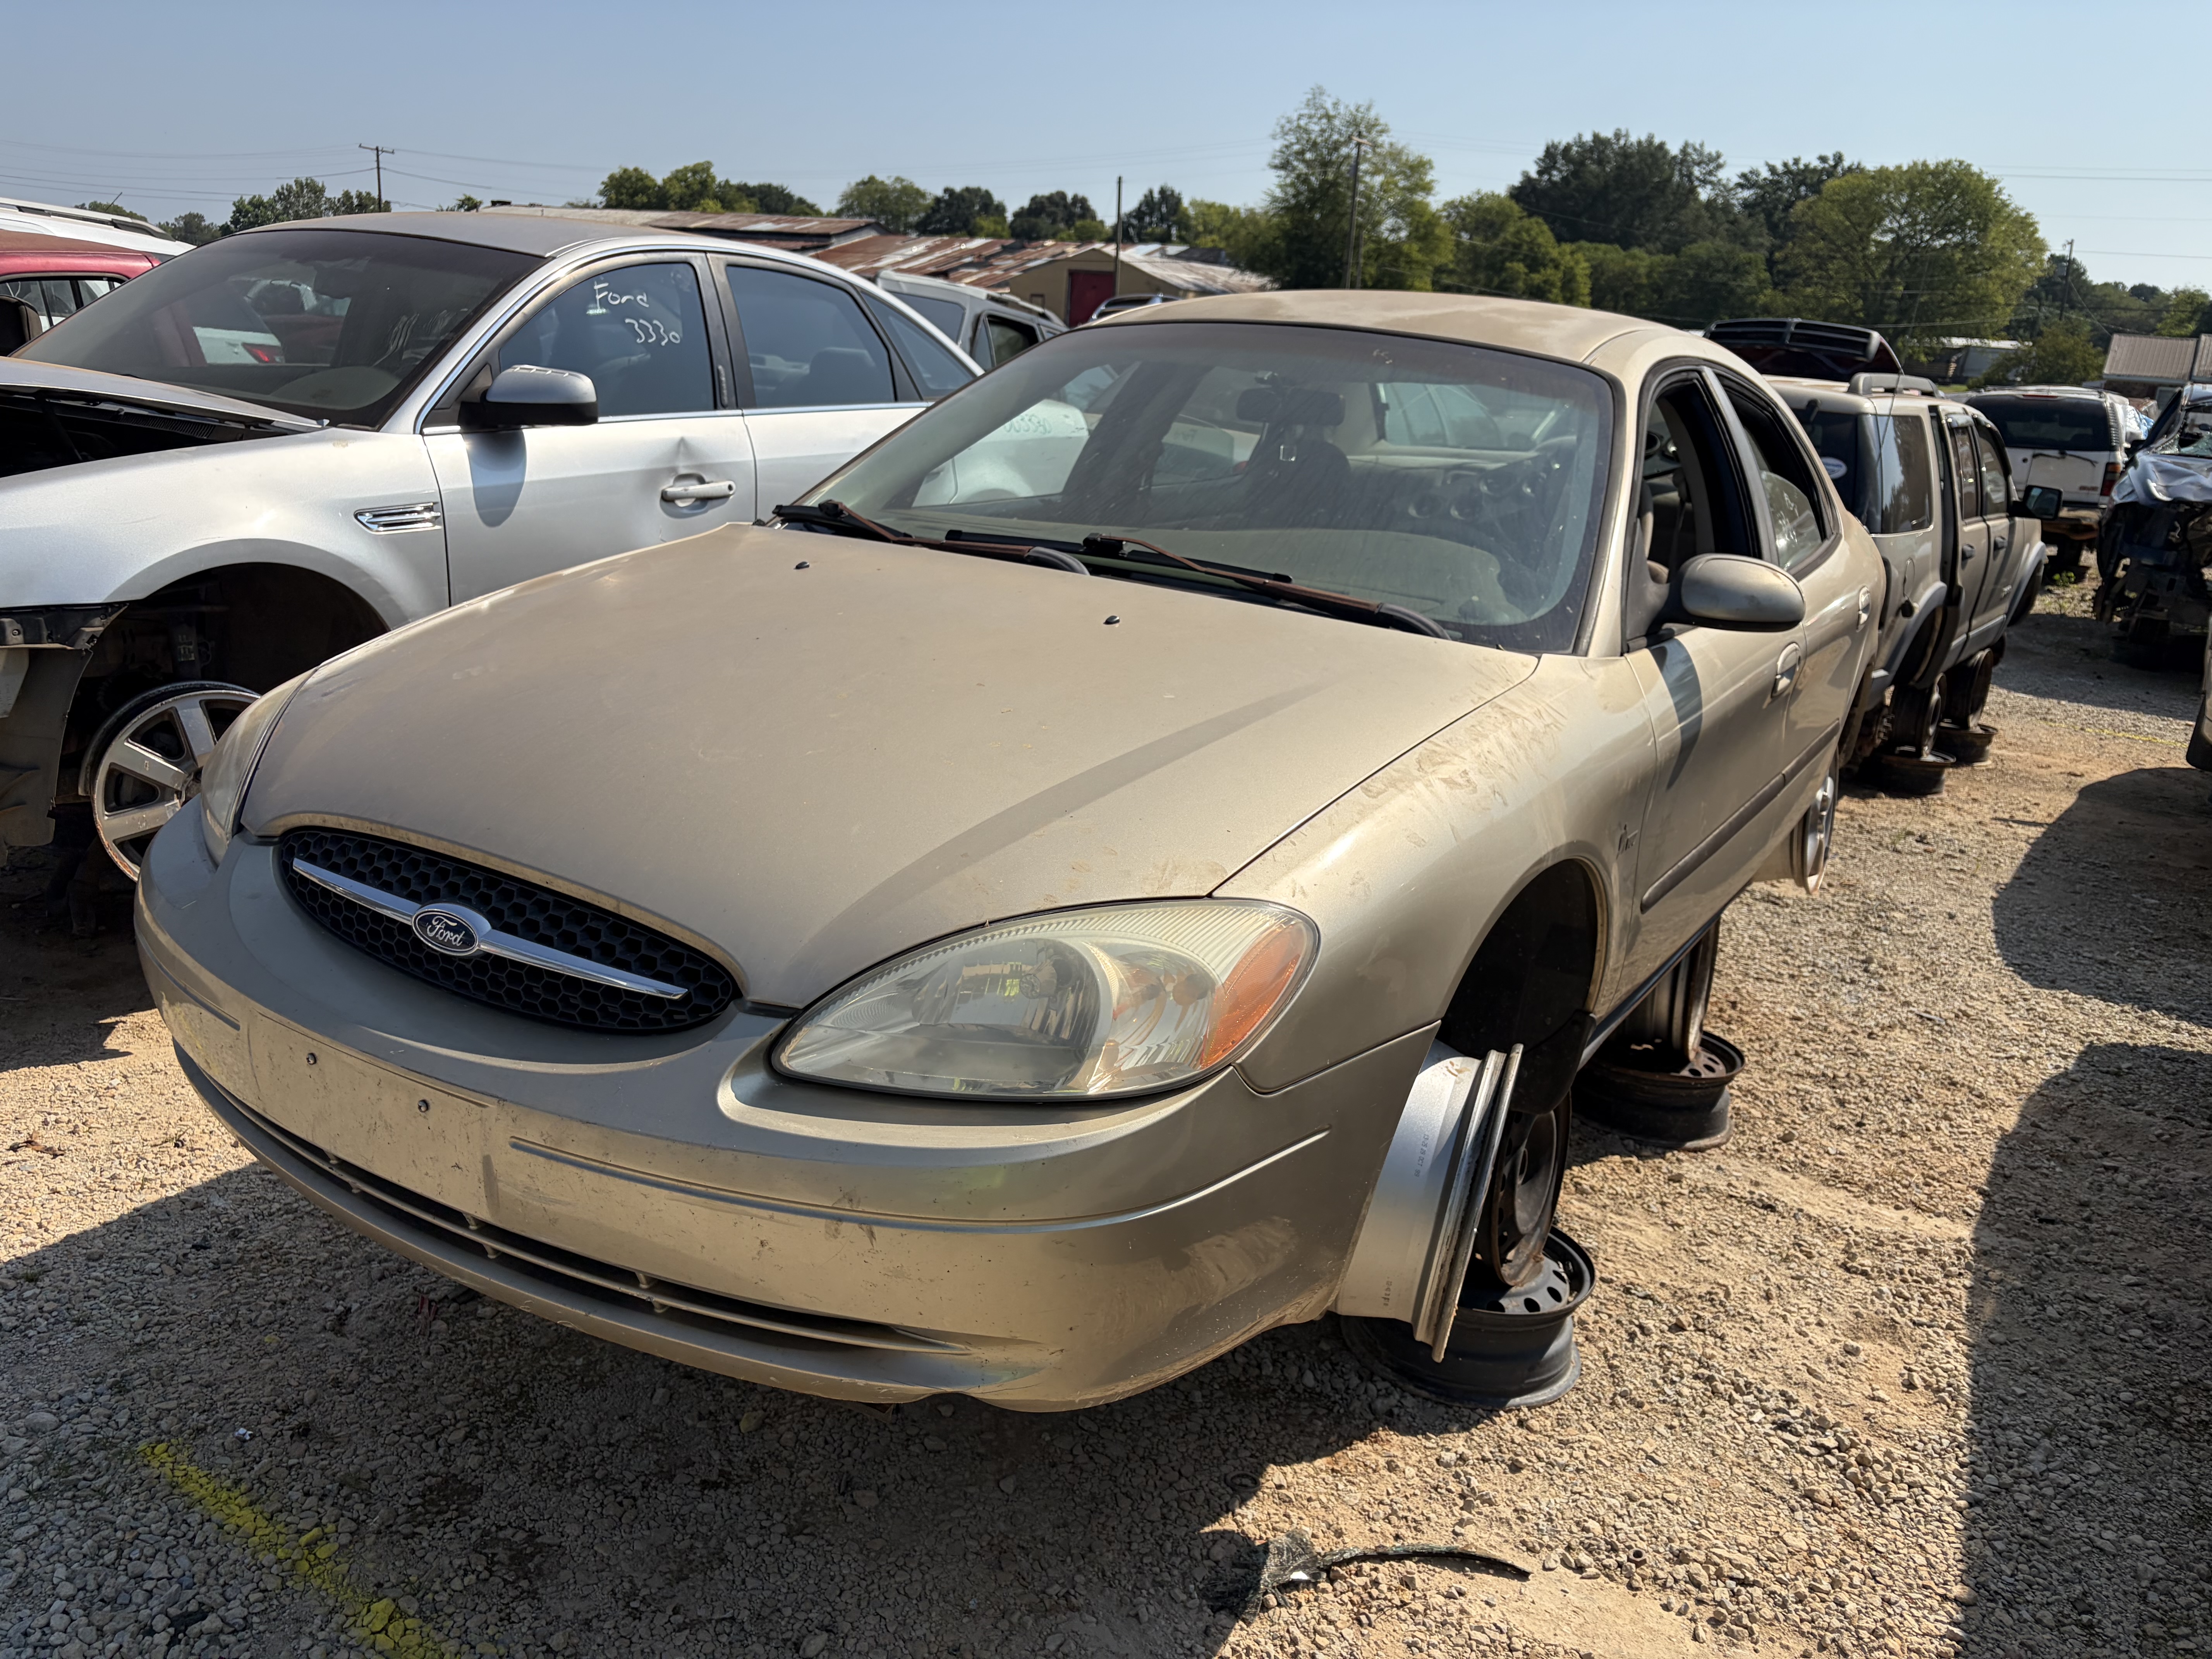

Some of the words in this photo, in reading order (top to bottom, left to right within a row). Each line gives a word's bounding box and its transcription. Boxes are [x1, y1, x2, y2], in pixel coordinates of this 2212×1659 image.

[594, 281, 649, 310] Ford
[624, 318, 680, 346] 3330
[426, 915, 465, 946] Ford
